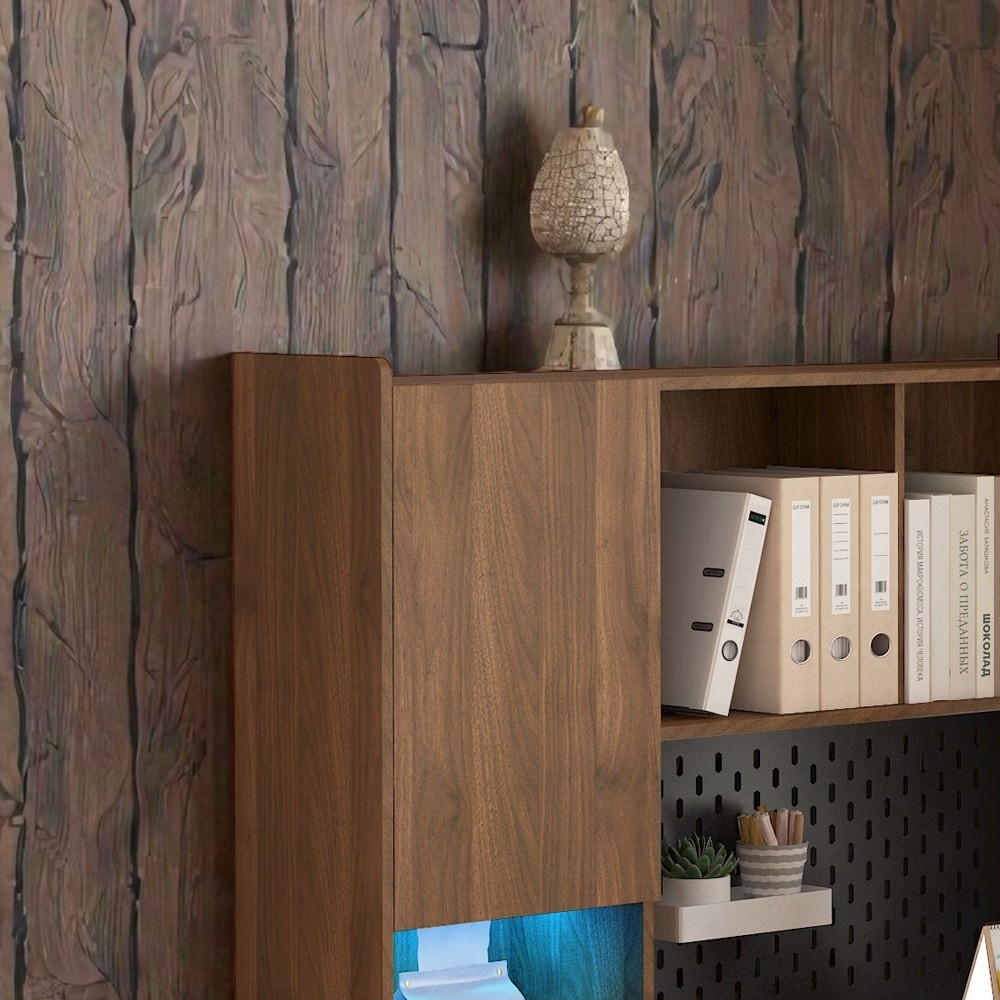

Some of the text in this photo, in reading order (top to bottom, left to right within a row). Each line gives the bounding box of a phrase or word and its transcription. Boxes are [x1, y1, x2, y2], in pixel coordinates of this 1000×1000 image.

[958, 530, 969, 674] ЗАБОТА О ПРЕДАННЫХ
[982, 614, 991, 678] ШОКОЛАД
